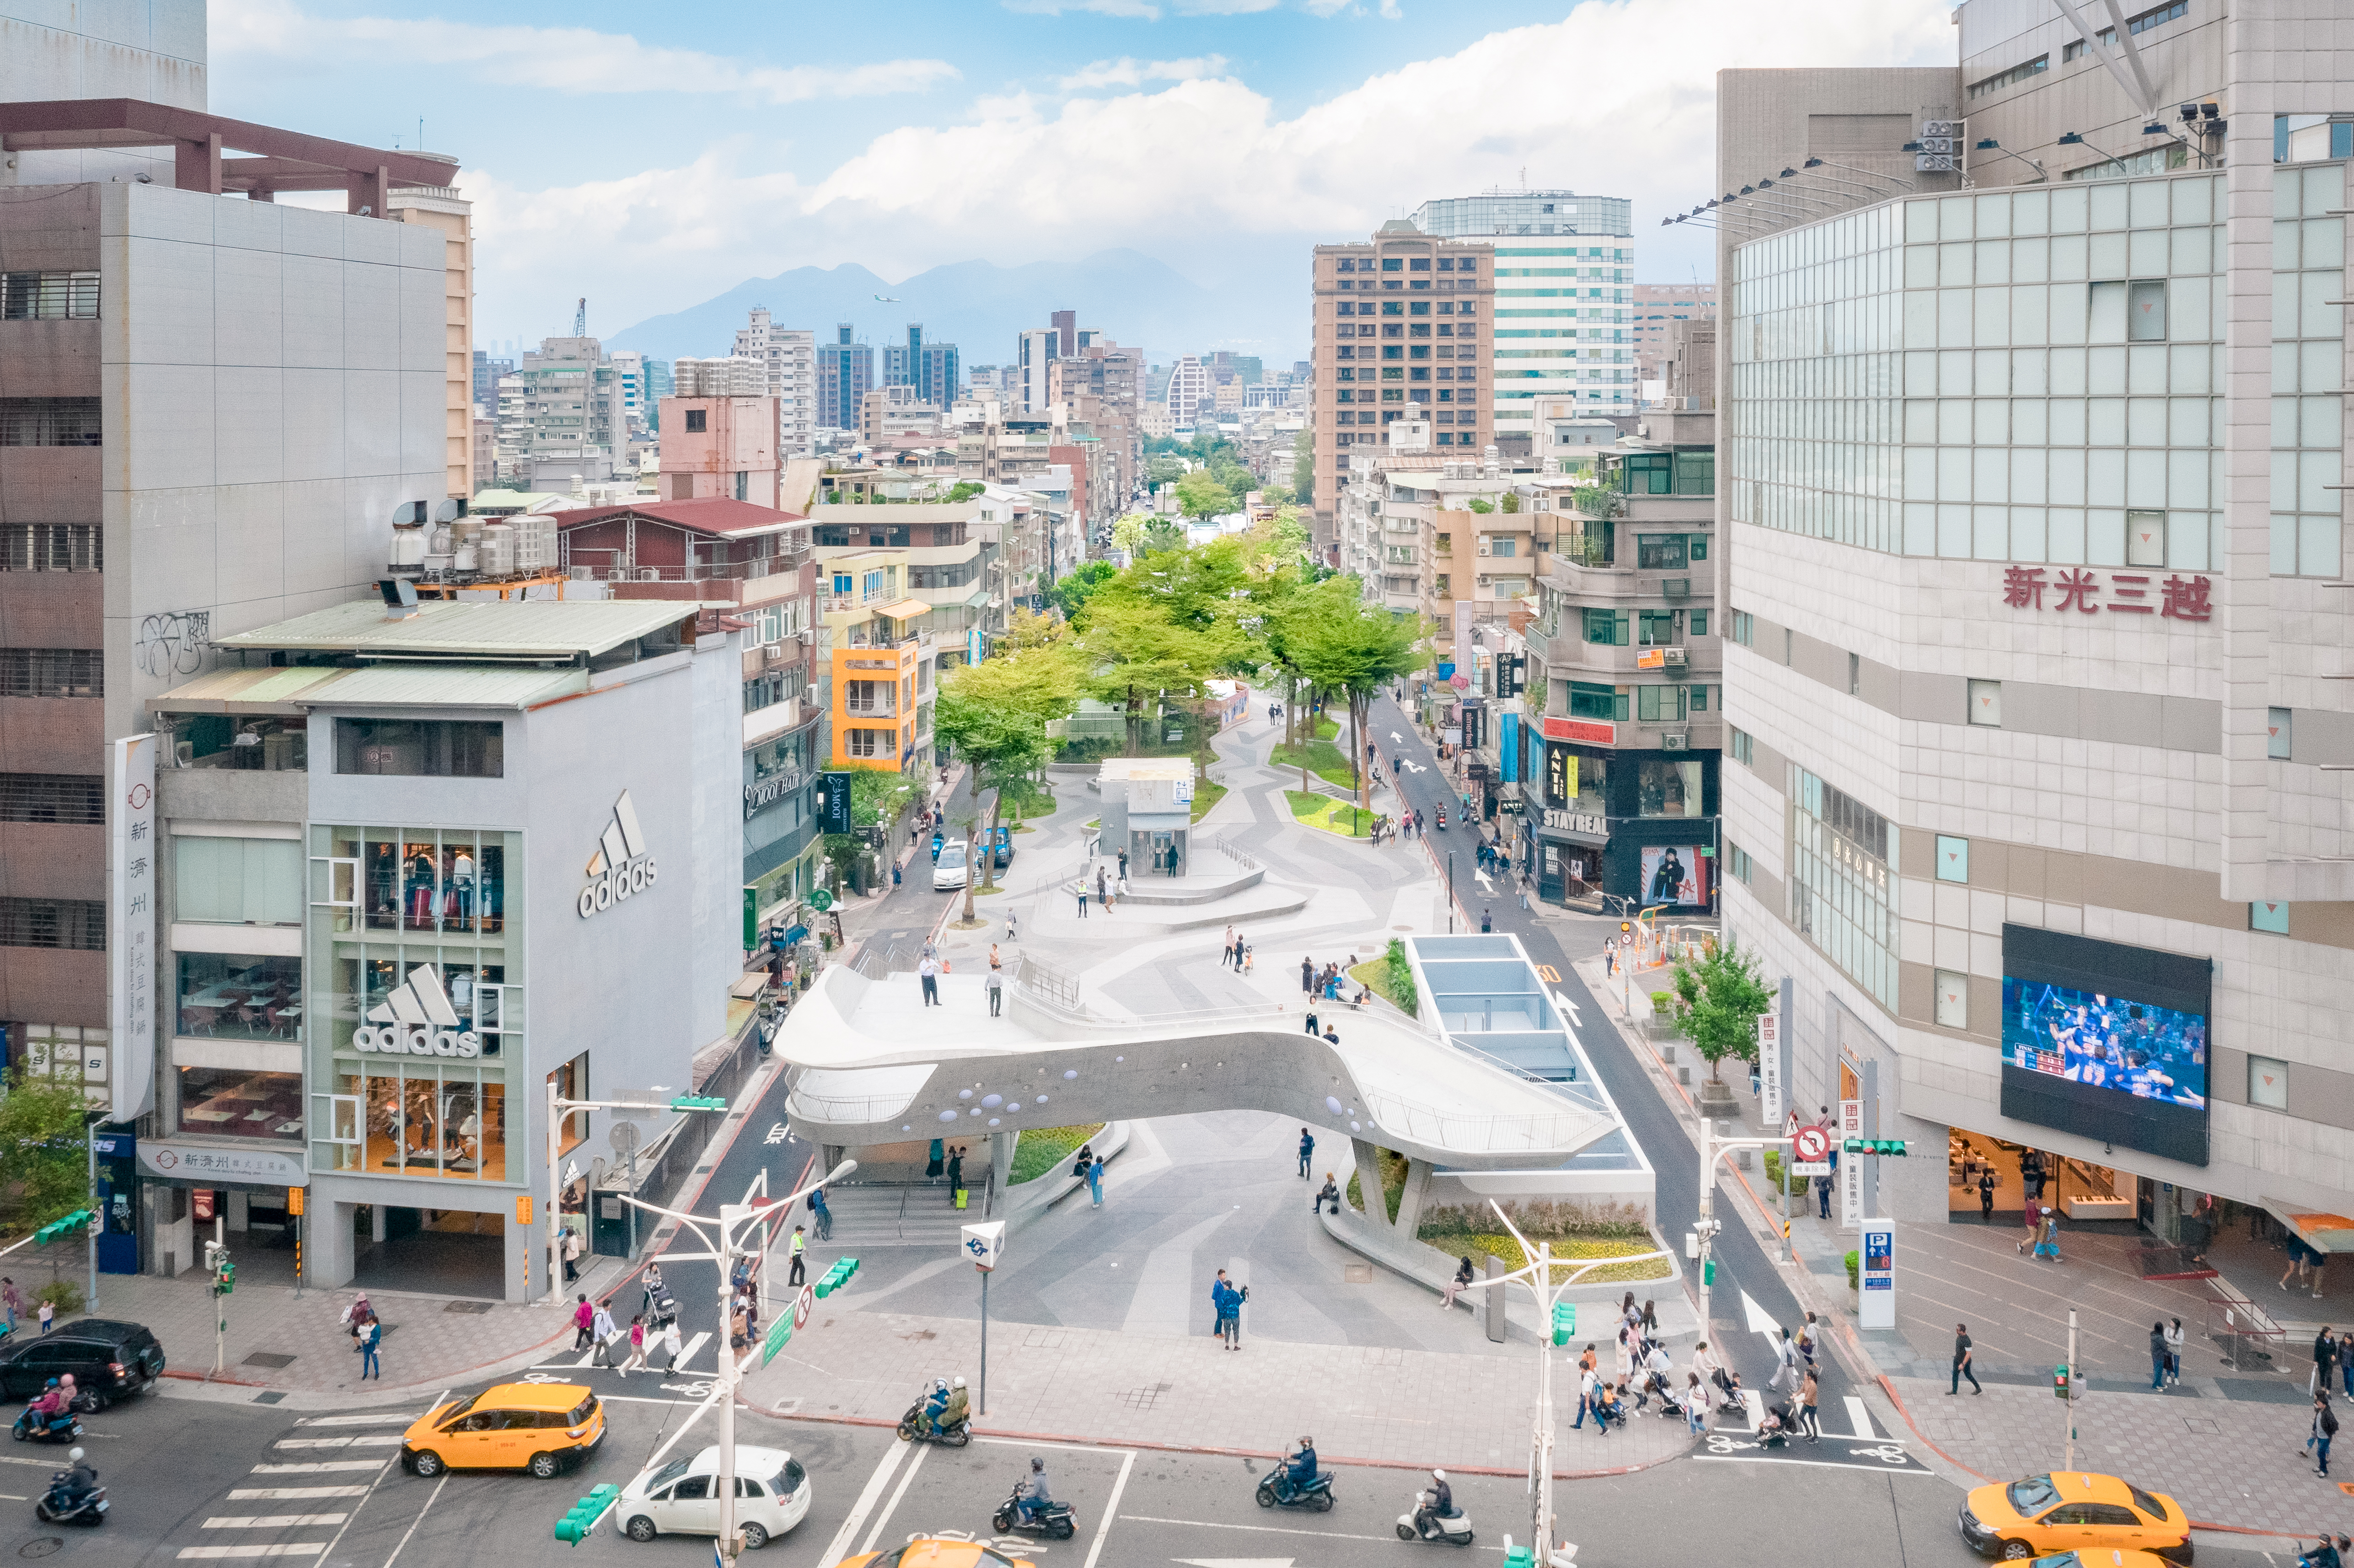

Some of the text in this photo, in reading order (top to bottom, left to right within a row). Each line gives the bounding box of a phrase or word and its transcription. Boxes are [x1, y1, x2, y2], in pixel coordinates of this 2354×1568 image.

[2003, 565, 2212, 622] 新光三越
[1551, 749, 1561, 795] ANTI
[756, 773, 800, 807] MOOI HAIR
[832, 794, 841, 819] MOOI
[1544, 809, 1610, 836] STAYREAL
[130, 821, 148, 915] 新濟州
[577, 857, 658, 918] adidas
[353, 1020, 478, 1058] adidas
[89, 1060, 102, 1068] S
[2083, 1065, 2105, 1086] 57
[185, 1153, 229, 1169] 新濟州
[562, 1171, 580, 1188] adidas
[1873, 1236, 1884, 1244] P
